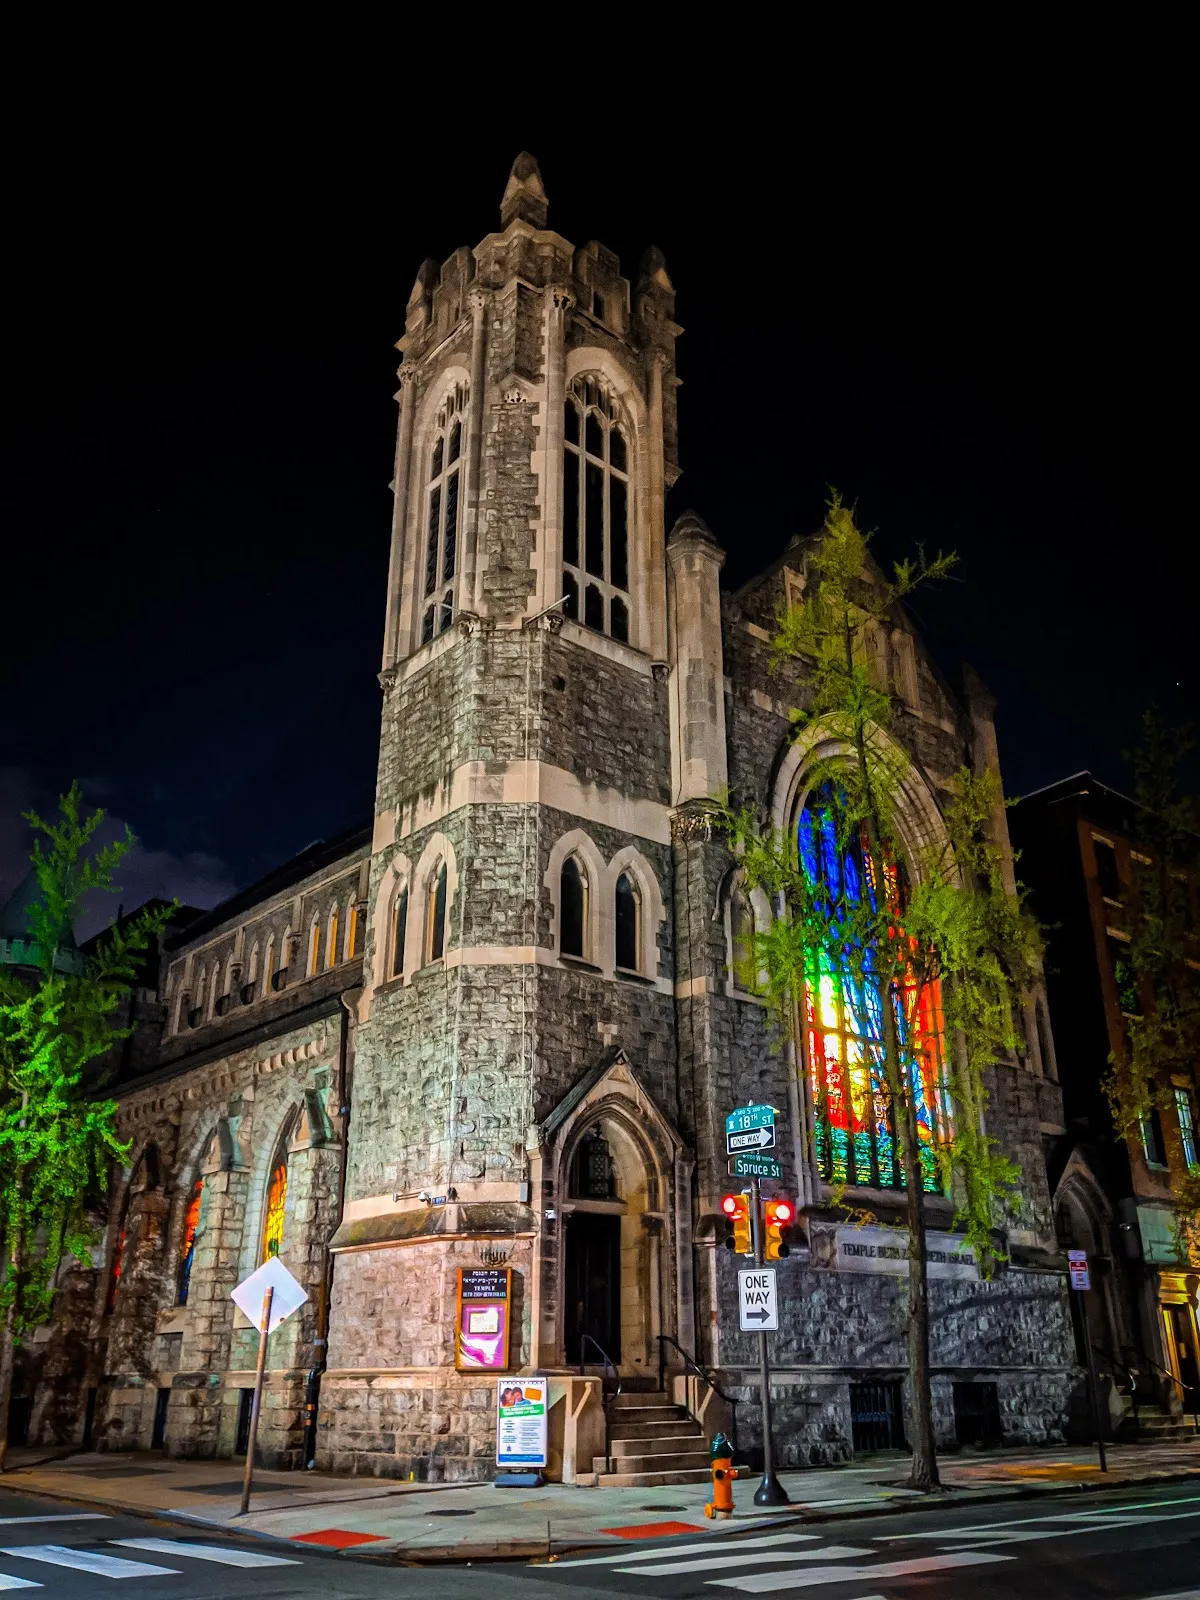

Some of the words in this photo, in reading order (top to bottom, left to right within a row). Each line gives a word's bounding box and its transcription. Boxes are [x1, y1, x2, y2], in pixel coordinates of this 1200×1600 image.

[738, 1113, 757, 1128] 18TH
[762, 1115, 771, 1124] ST
[732, 1137, 745, 1146] ONE
[747, 1134, 760, 1143] WAY
[738, 1160, 768, 1175] Spruce
[771, 1165, 779, 1177] St
[842, 1243, 877, 1258] TEMPLE
[745, 1276, 769, 1288] ONE
[745, 1291, 770, 1304] WAY
